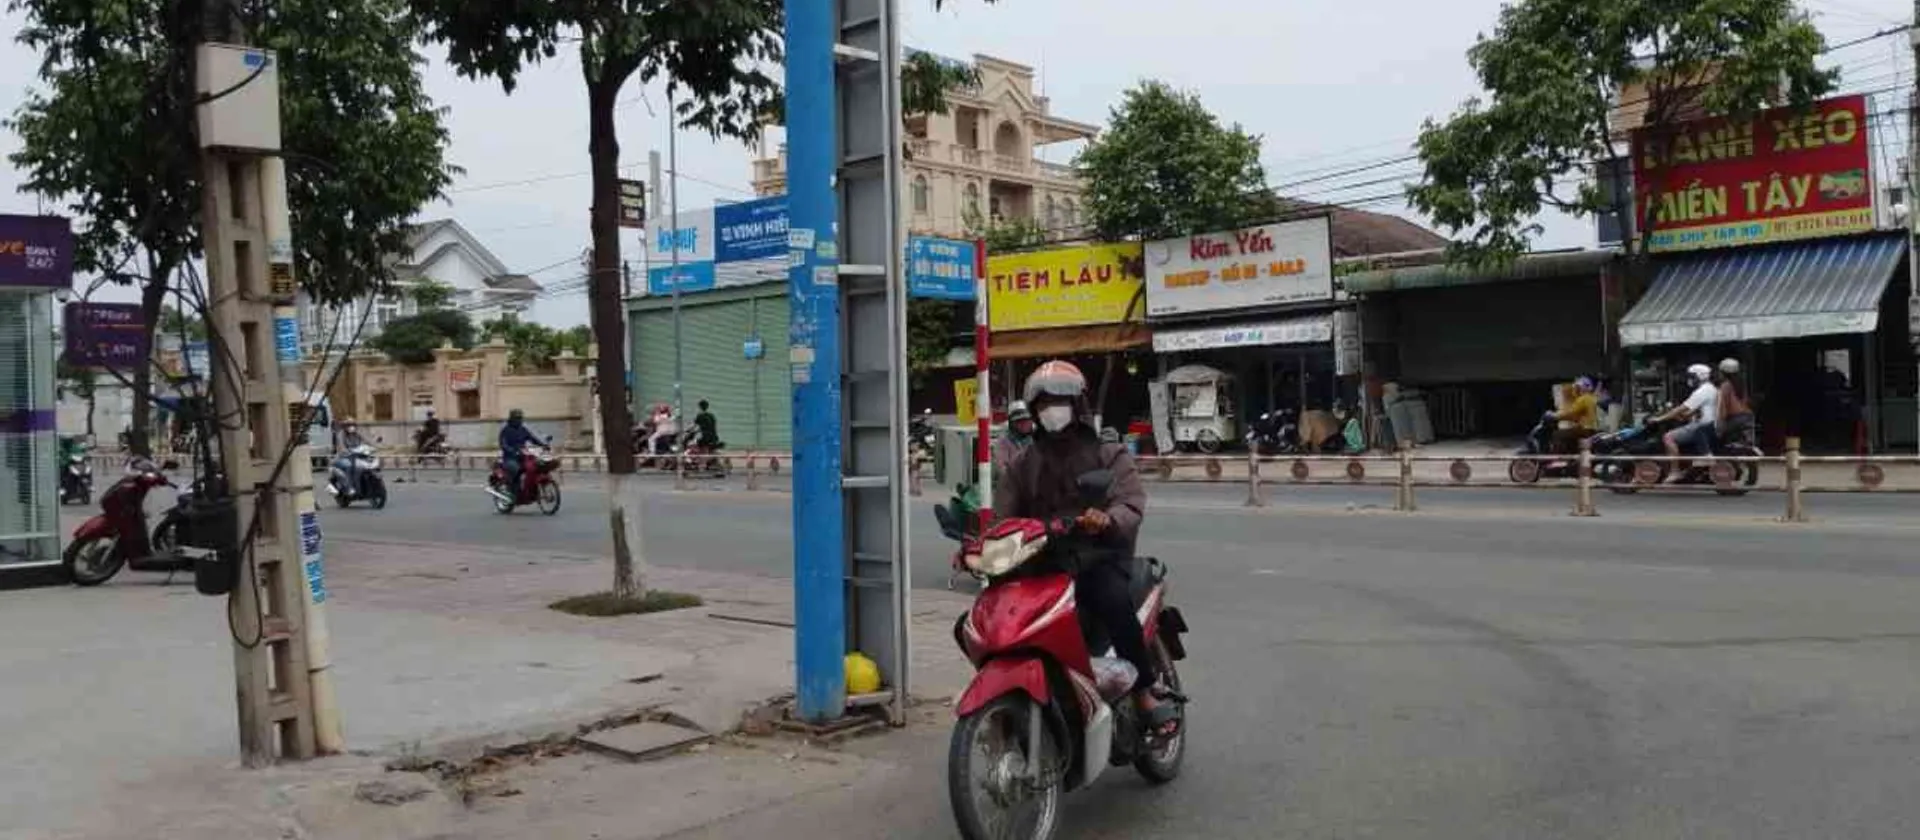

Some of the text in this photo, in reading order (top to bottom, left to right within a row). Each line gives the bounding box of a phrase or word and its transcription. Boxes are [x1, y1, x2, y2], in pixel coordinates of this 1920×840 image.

[1741, 171, 1813, 213] TÂY
[733, 222, 763, 240] VINH
[1190, 228, 1275, 261] Kim Yến
[991, 267, 1050, 293] TIỆM
